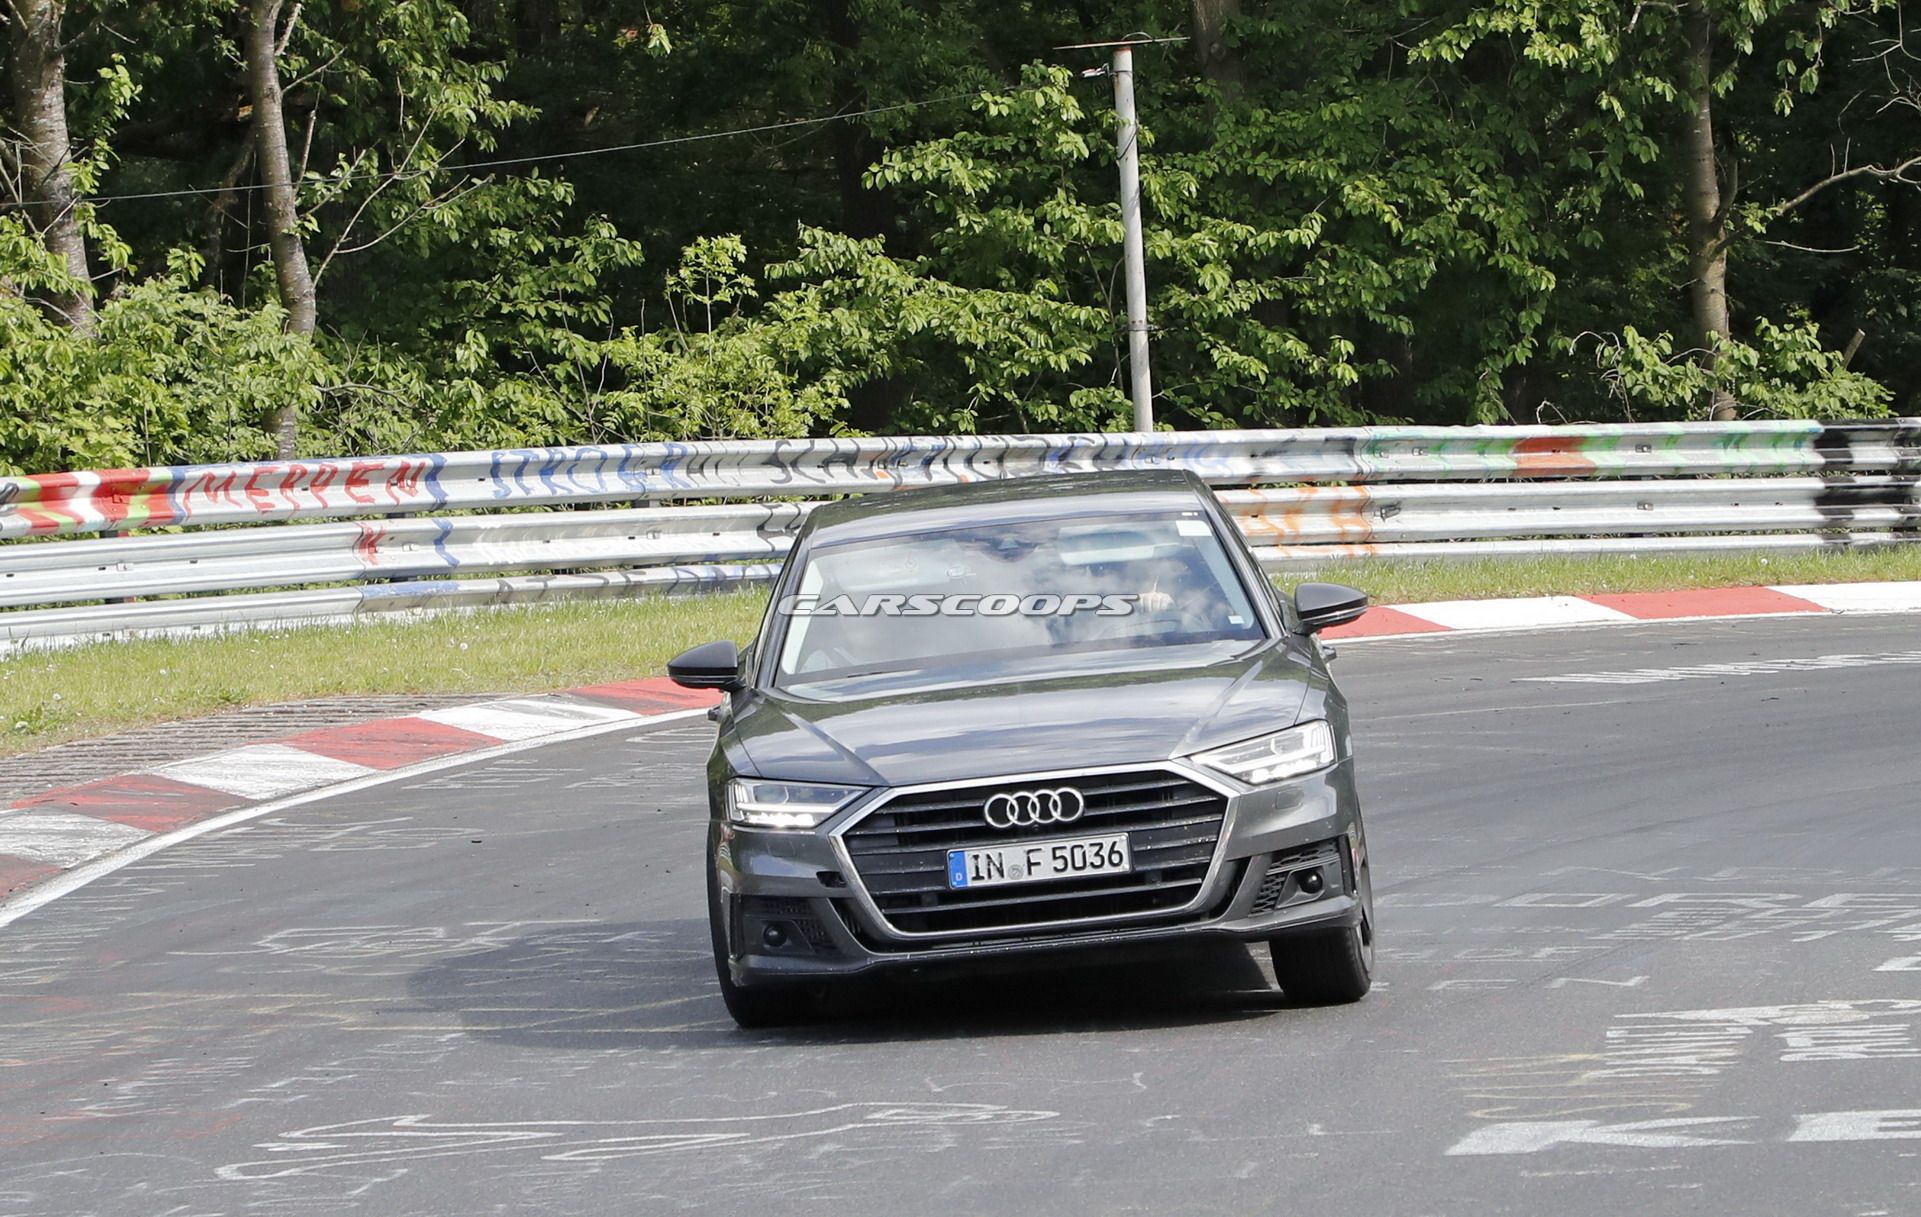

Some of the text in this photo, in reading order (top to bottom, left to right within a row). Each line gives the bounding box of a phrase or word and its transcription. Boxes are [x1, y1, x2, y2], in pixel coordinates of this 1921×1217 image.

[971, 840, 1124, 881] IN F 5036
